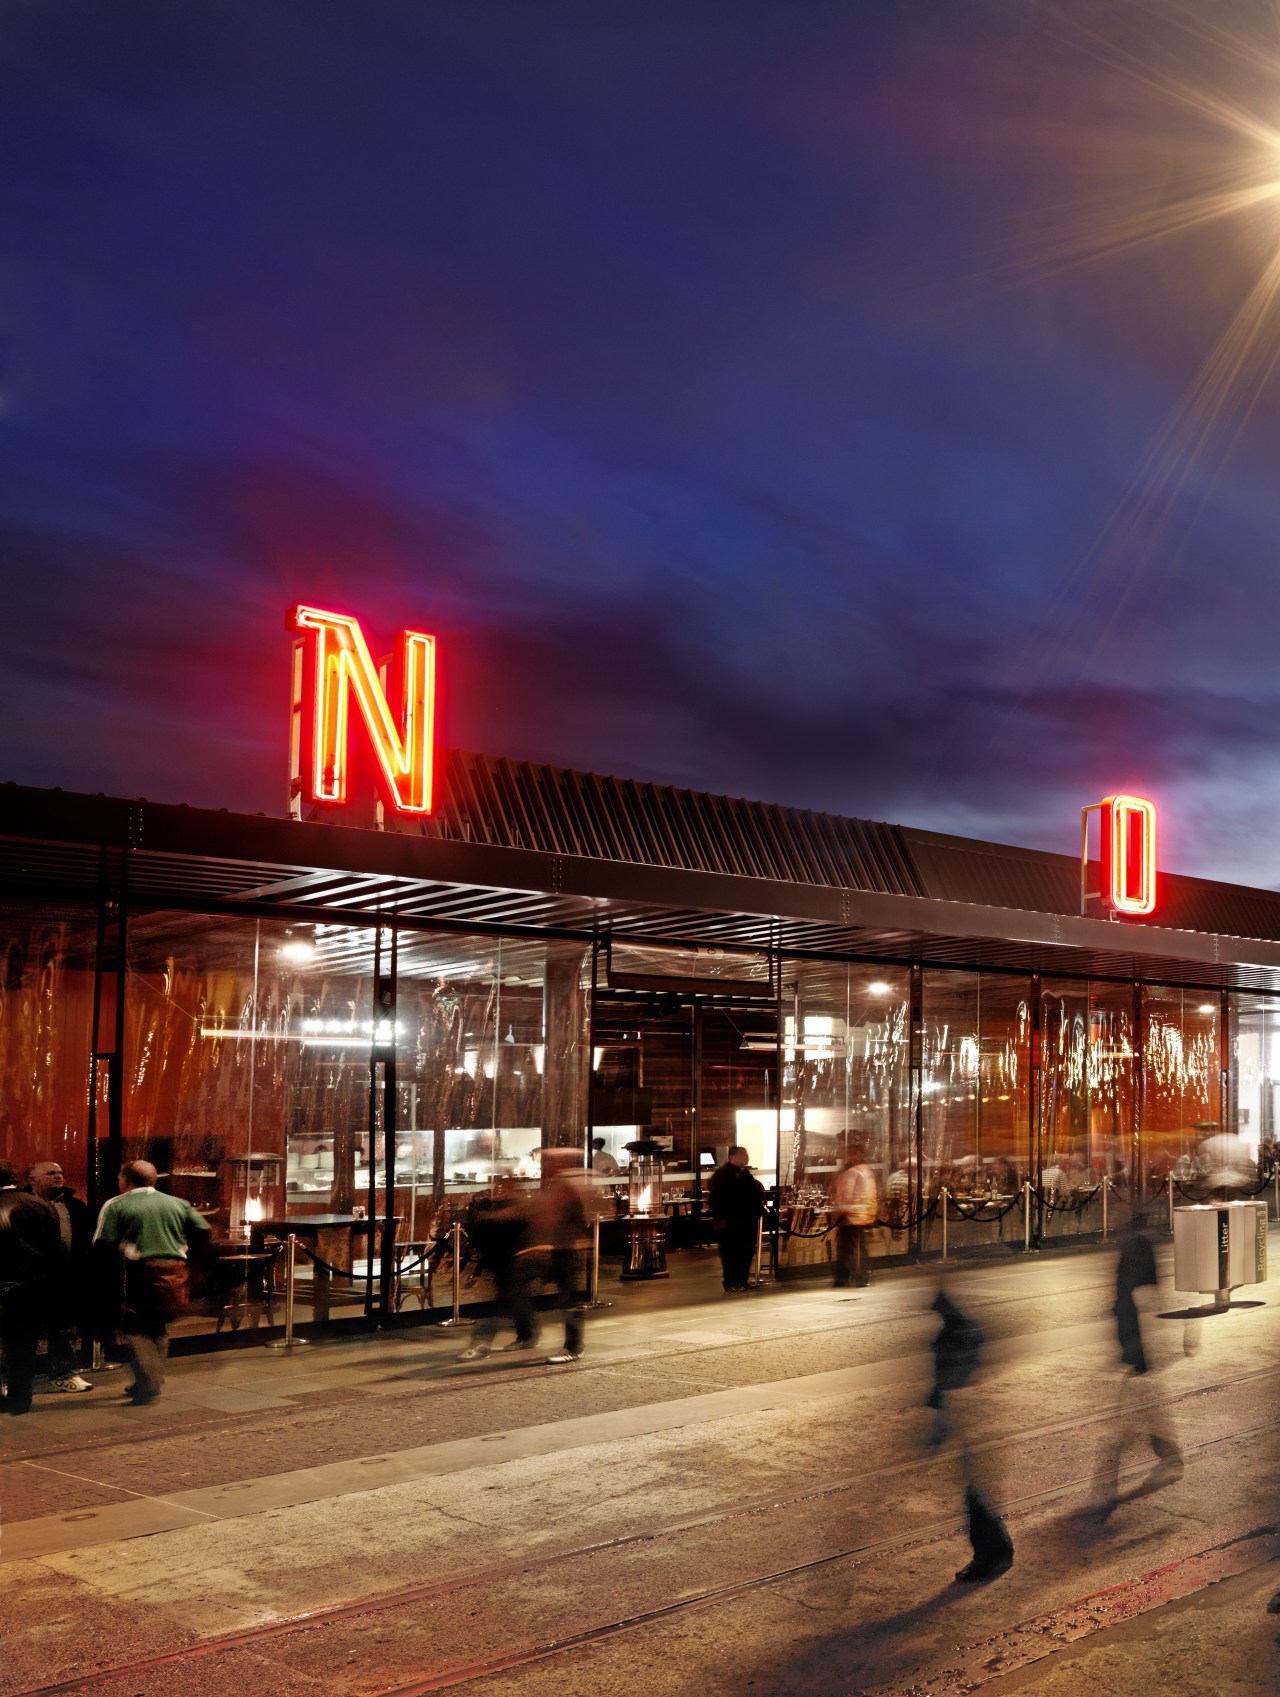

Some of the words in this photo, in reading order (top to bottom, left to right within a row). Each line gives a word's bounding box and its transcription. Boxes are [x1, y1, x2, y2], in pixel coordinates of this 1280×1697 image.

[292, 604, 436, 815] N
[1108, 794, 1157, 914] O
[1257, 1218, 1266, 1271] Recycling
